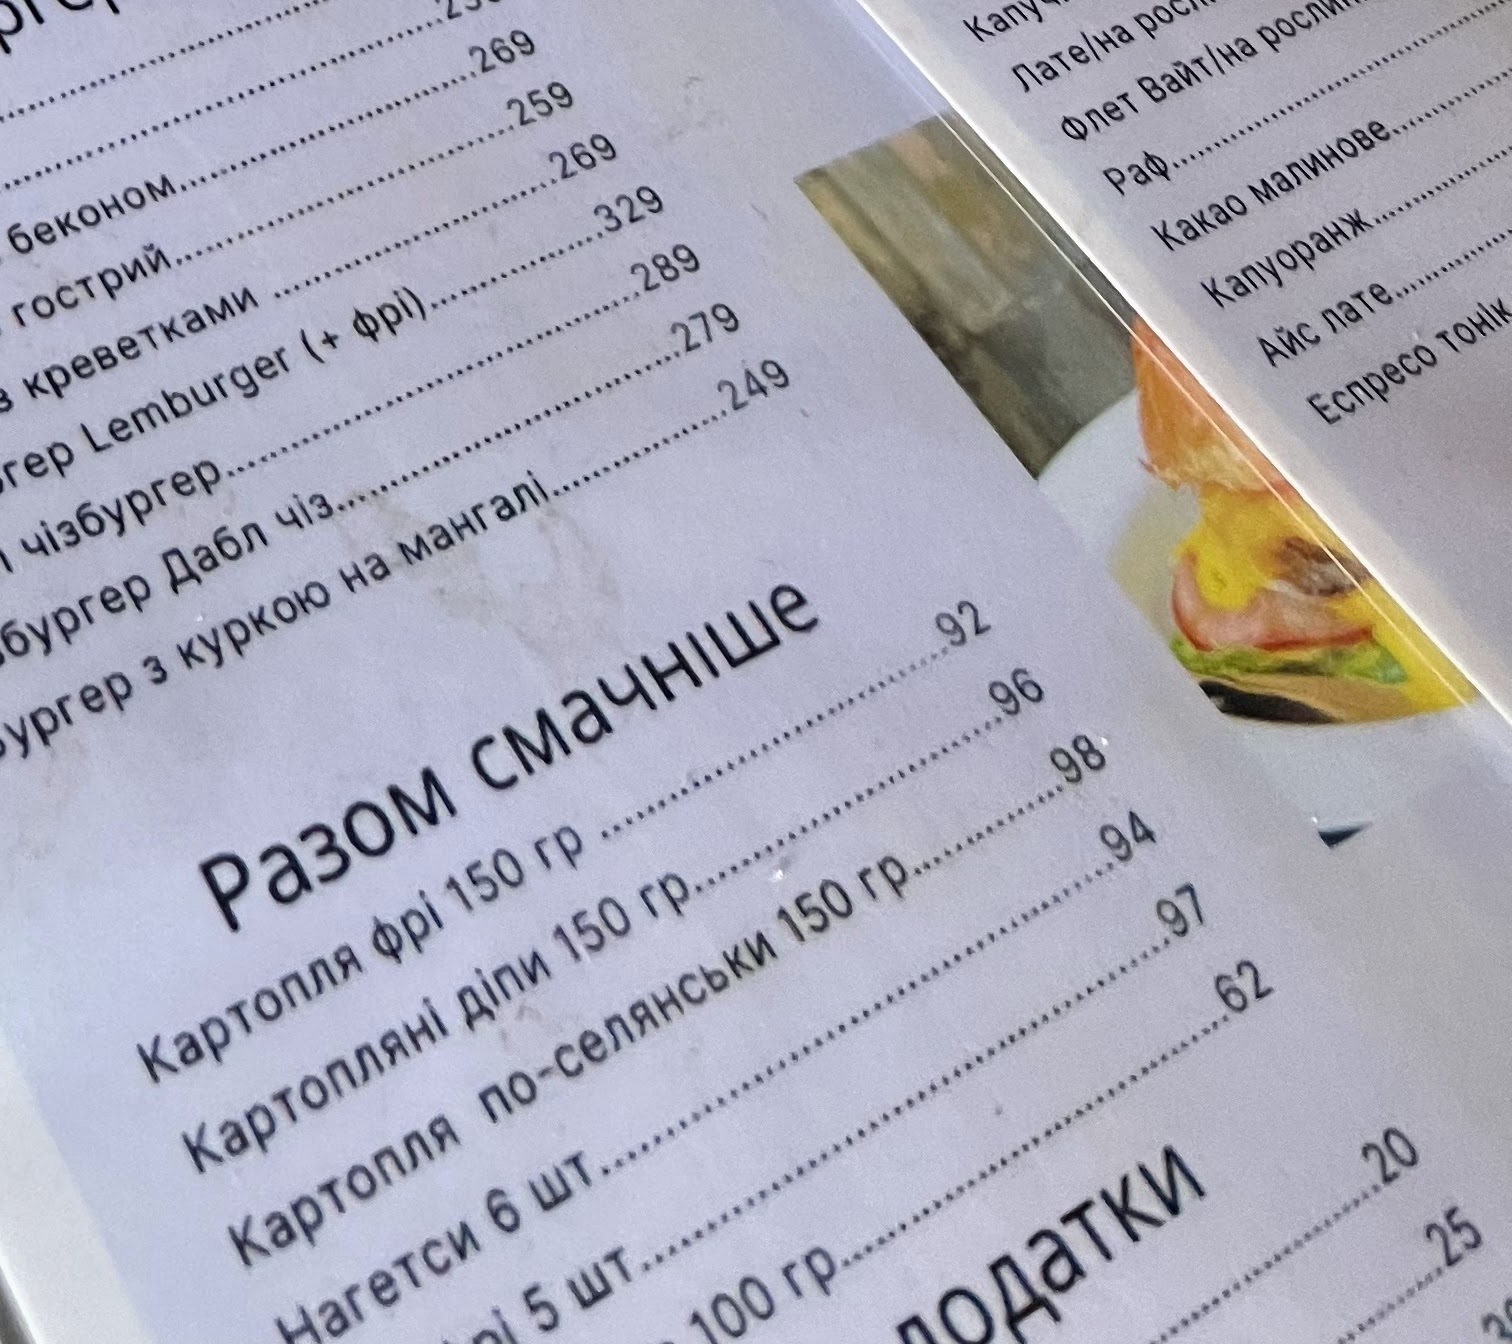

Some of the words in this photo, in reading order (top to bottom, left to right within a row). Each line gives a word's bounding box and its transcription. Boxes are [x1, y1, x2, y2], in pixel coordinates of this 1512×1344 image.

[8, 174, 176, 256] беконом
[469, 30, 536, 73] 269
[1012, 21, 1135, 92] Лате/на
[1060, 88, 1139, 143] Флет
[1138, 30, 1257, 105] Вайт/на
[1102, 150, 1172, 195] Раф
[1151, 194, 1247, 251] Какао
[1248, 118, 1390, 205] малинове
[12, 243, 172, 328] гострий
[506, 81, 574, 127] 259
[22, 286, 259, 401] креветками
[549, 134, 617, 179] 269
[80, 346, 289, 453] Lemburger
[354, 286, 427, 343] фрі)
[594, 185, 664, 234] 329
[1201, 208, 1370, 309] Капуоранж
[1256, 320, 1321, 368] Айс
[1322, 283, 1393, 334] лате
[21, 458, 222, 559] чізбургер
[630, 244, 700, 293] 289
[160, 519, 268, 595] Дабл
[275, 490, 333, 532] чіз
[670, 302, 740, 353] 279
[1306, 345, 1437, 425] Еспресо
[1435, 298, 1512, 353] тонік
[143, 654, 169, 685] з
[177, 581, 331, 671] куркою
[340, 551, 391, 595] на
[397, 470, 553, 566] мангалі
[717, 360, 790, 412] 249
[137, 944, 359, 1084] Картопля
[372, 889, 447, 966] фрі
[448, 847, 524, 915] 150
[533, 824, 584, 875] гр
[935, 600, 991, 647] 92
[199, 766, 457, 933] Разом
[471, 581, 821, 793] смачніше
[182, 1001, 449, 1175] Картопляні
[457, 951, 552, 1035] діпи
[555, 897, 630, 964] 150
[640, 872, 690, 923] гр
[989, 668, 1045, 716] 96
[228, 1113, 460, 1269] Картопля
[478, 928, 778, 1123] по-селянськи
[777, 877, 853, 944] 150
[859, 853, 909, 905] гр
[1051, 733, 1107, 787] 98
[274, 1220, 482, 1344] Нагетси
[487, 1188, 520, 1233] 6
[529, 1150, 593, 1211] шт
[1099, 811, 1157, 863] 94
[522, 1281, 559, 1332] 5
[566, 1246, 633, 1308] шт
[1156, 881, 1207, 938] 97
[690, 1277, 775, 1344] 100
[782, 1246, 837, 1297] гр
[1214, 960, 1275, 1014] 62
[1361, 1127, 1419, 1185] 20
[1426, 1205, 1482, 1267] 25
